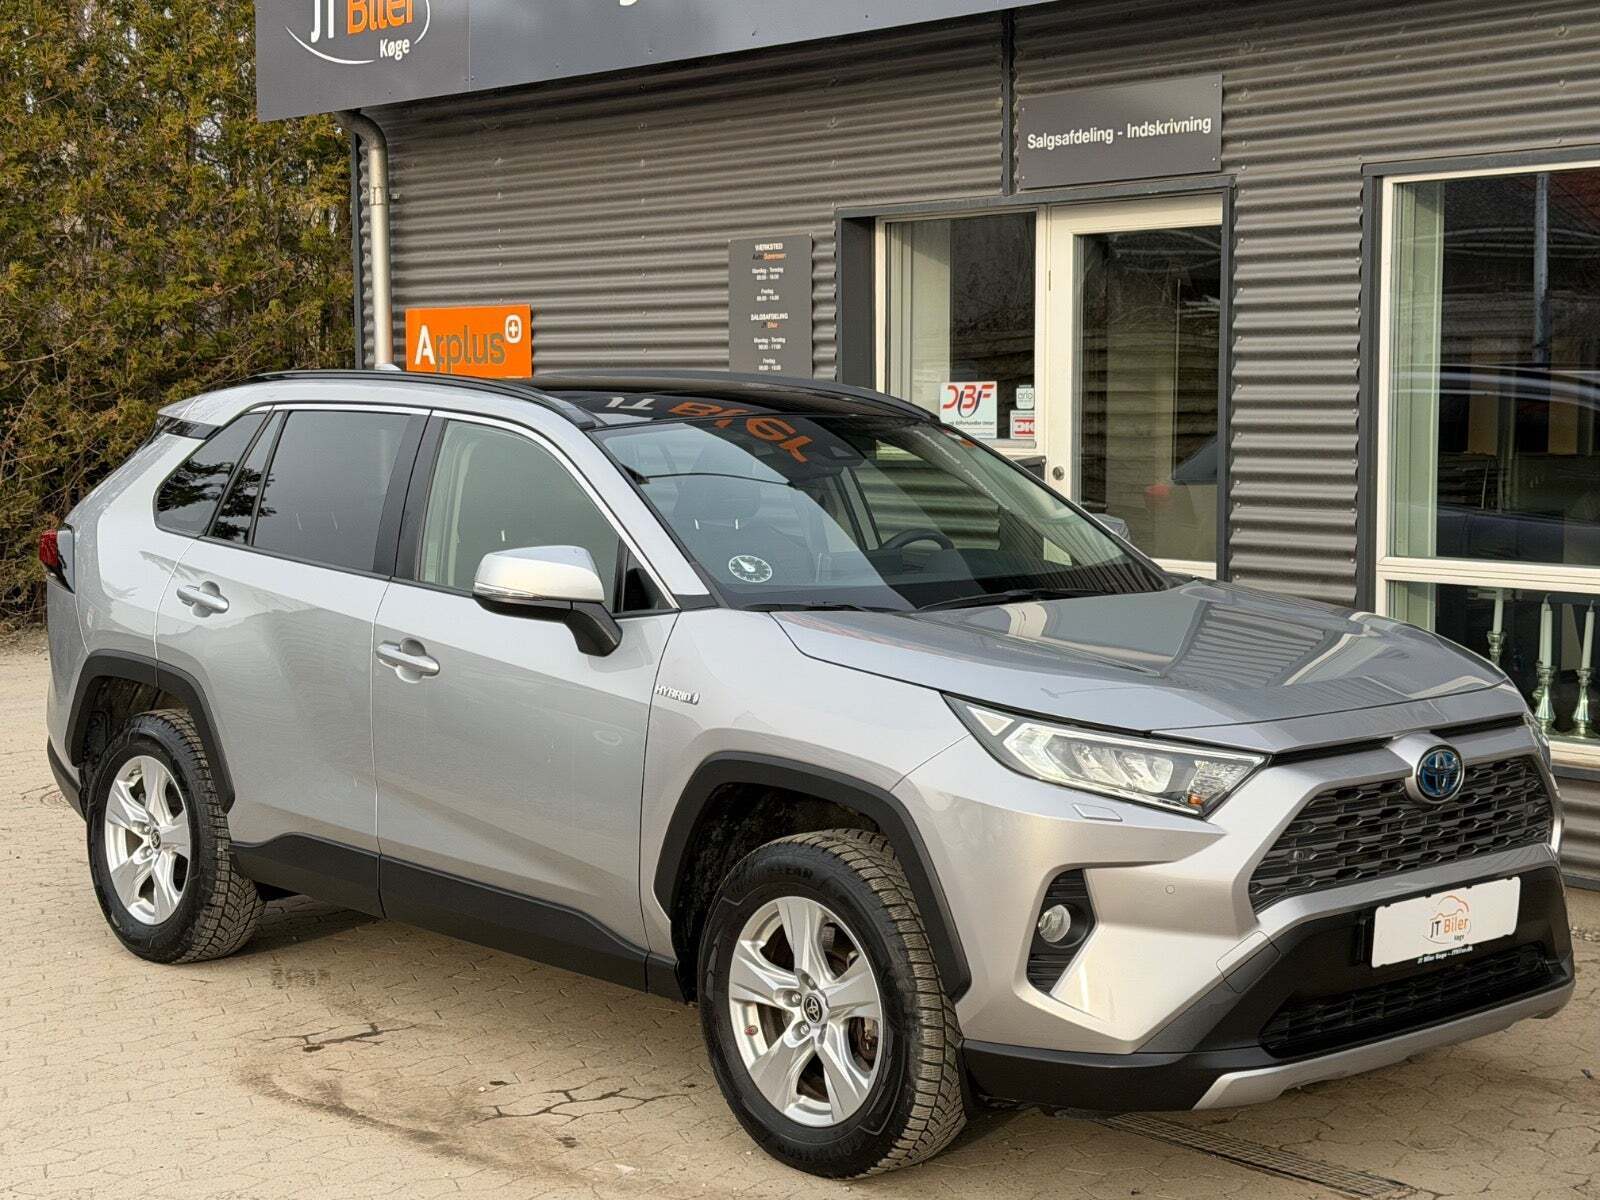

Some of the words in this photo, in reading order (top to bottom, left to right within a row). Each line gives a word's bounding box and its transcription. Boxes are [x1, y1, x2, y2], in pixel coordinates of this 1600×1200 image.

[379, 39, 410, 61] Køge
[1027, 127, 1114, 150] Salgsafdeling
[1127, 116, 1212, 138] Indskrivning
[655, 685, 691, 702] HYBRID
[1430, 920, 1441, 938] JT
[1444, 917, 1468, 933] Biler
